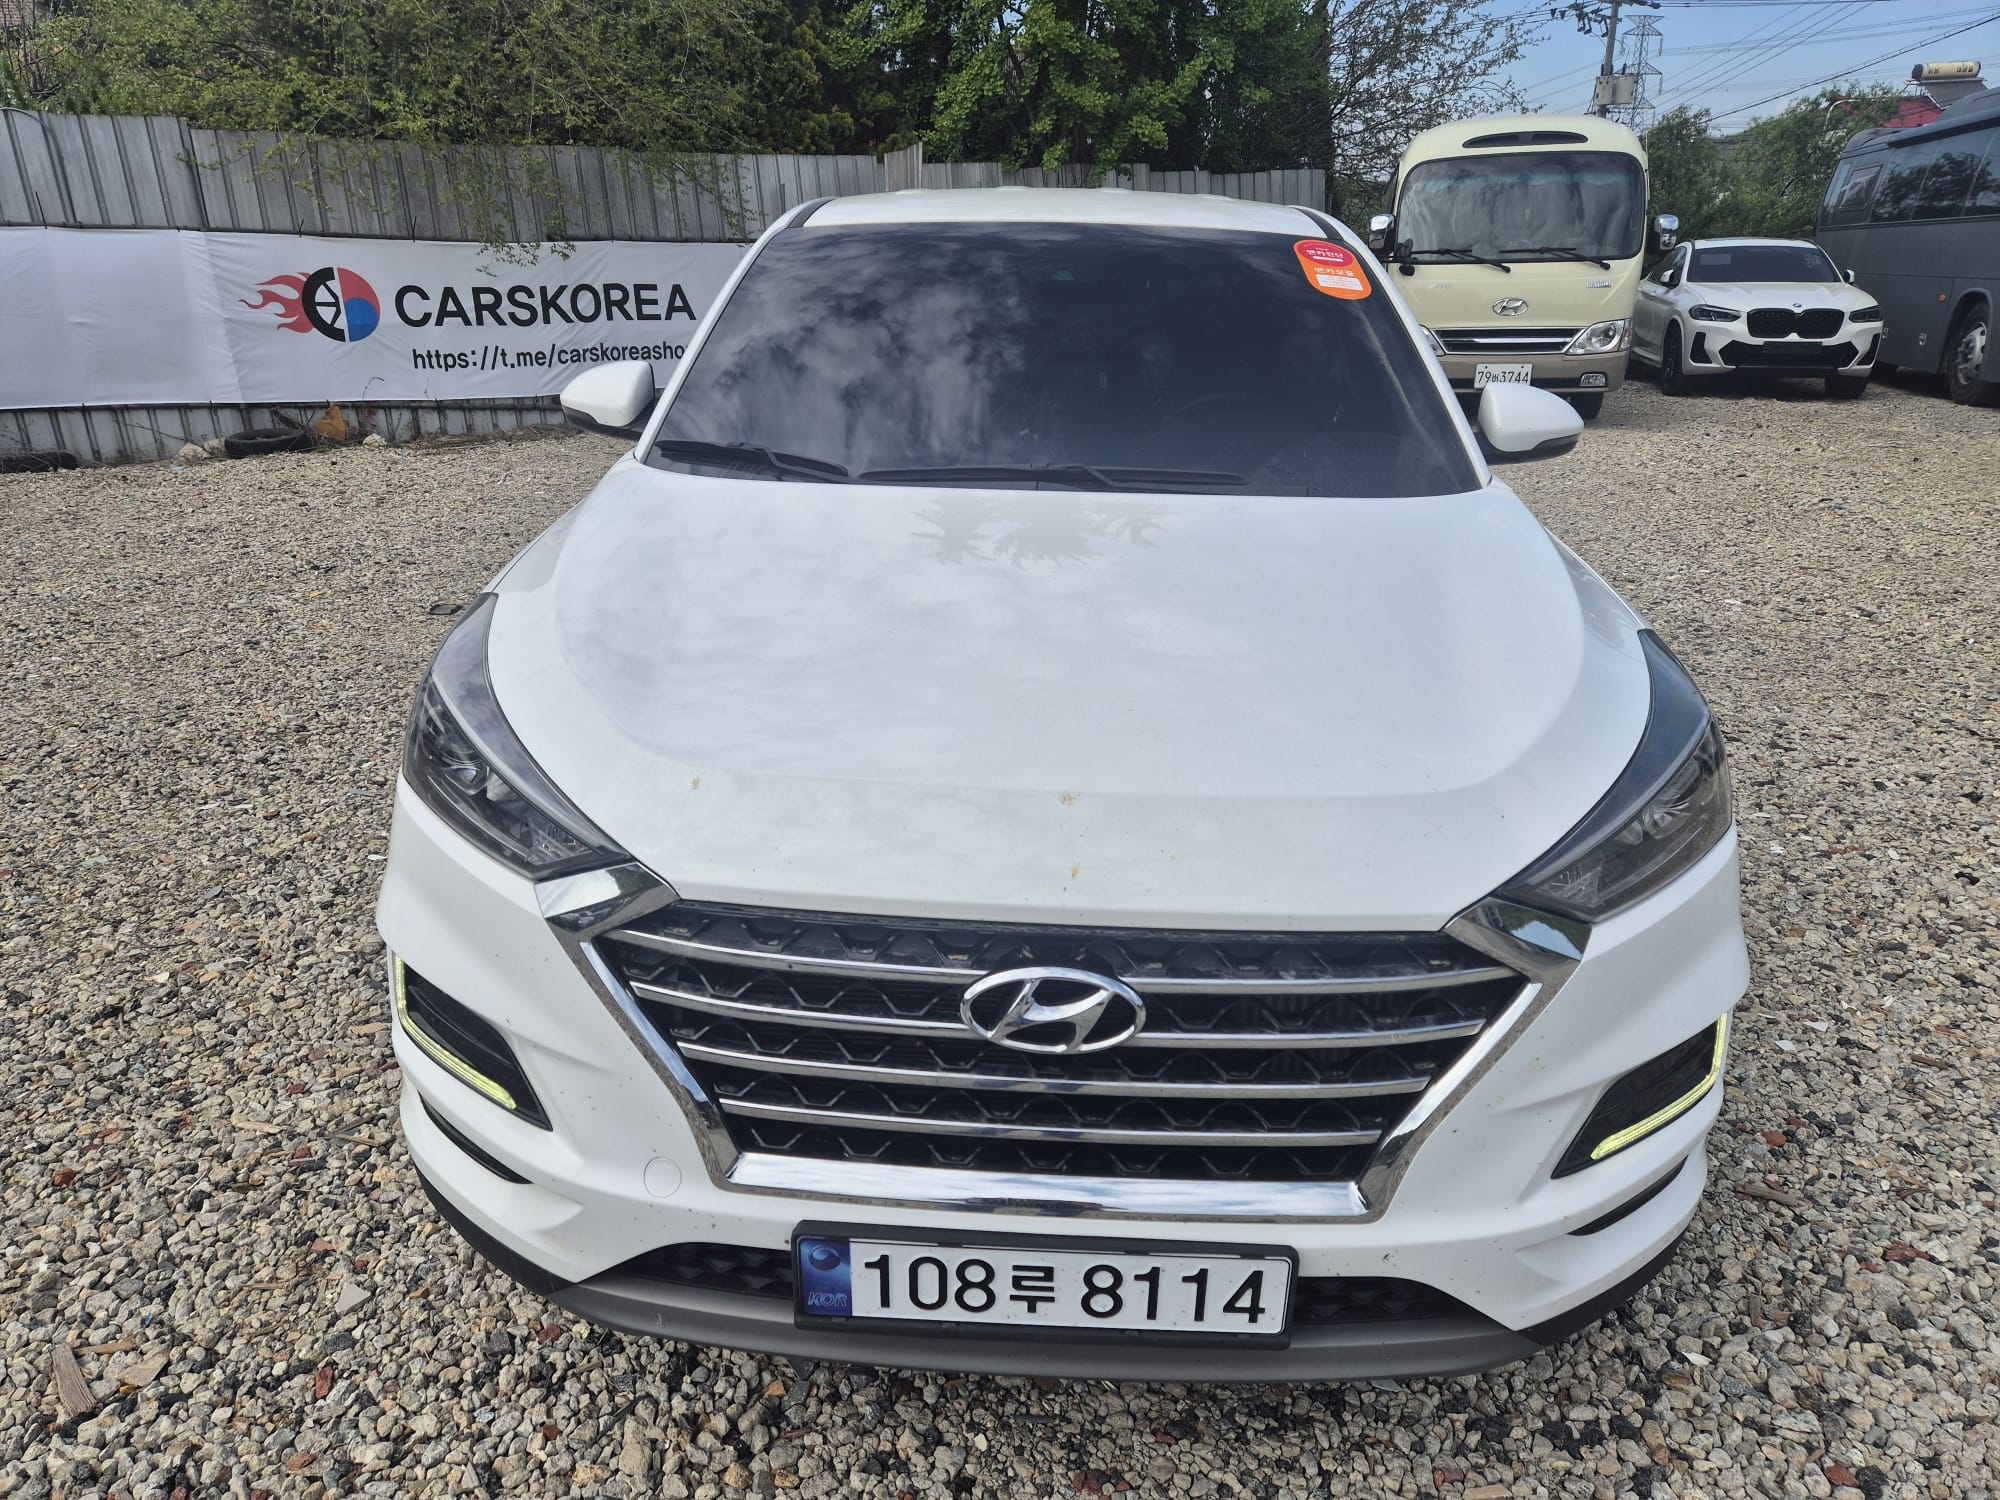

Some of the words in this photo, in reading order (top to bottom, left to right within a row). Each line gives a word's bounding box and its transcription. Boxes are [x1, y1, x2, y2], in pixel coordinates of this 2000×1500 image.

[394, 283, 697, 327] CARSKOREA
[412, 341, 689, 372] https://t.me/carskoreasho
[807, 1291, 848, 1307] KOR
[864, 1254, 1056, 1313] 108루
[1081, 1264, 1266, 1323] 8114
